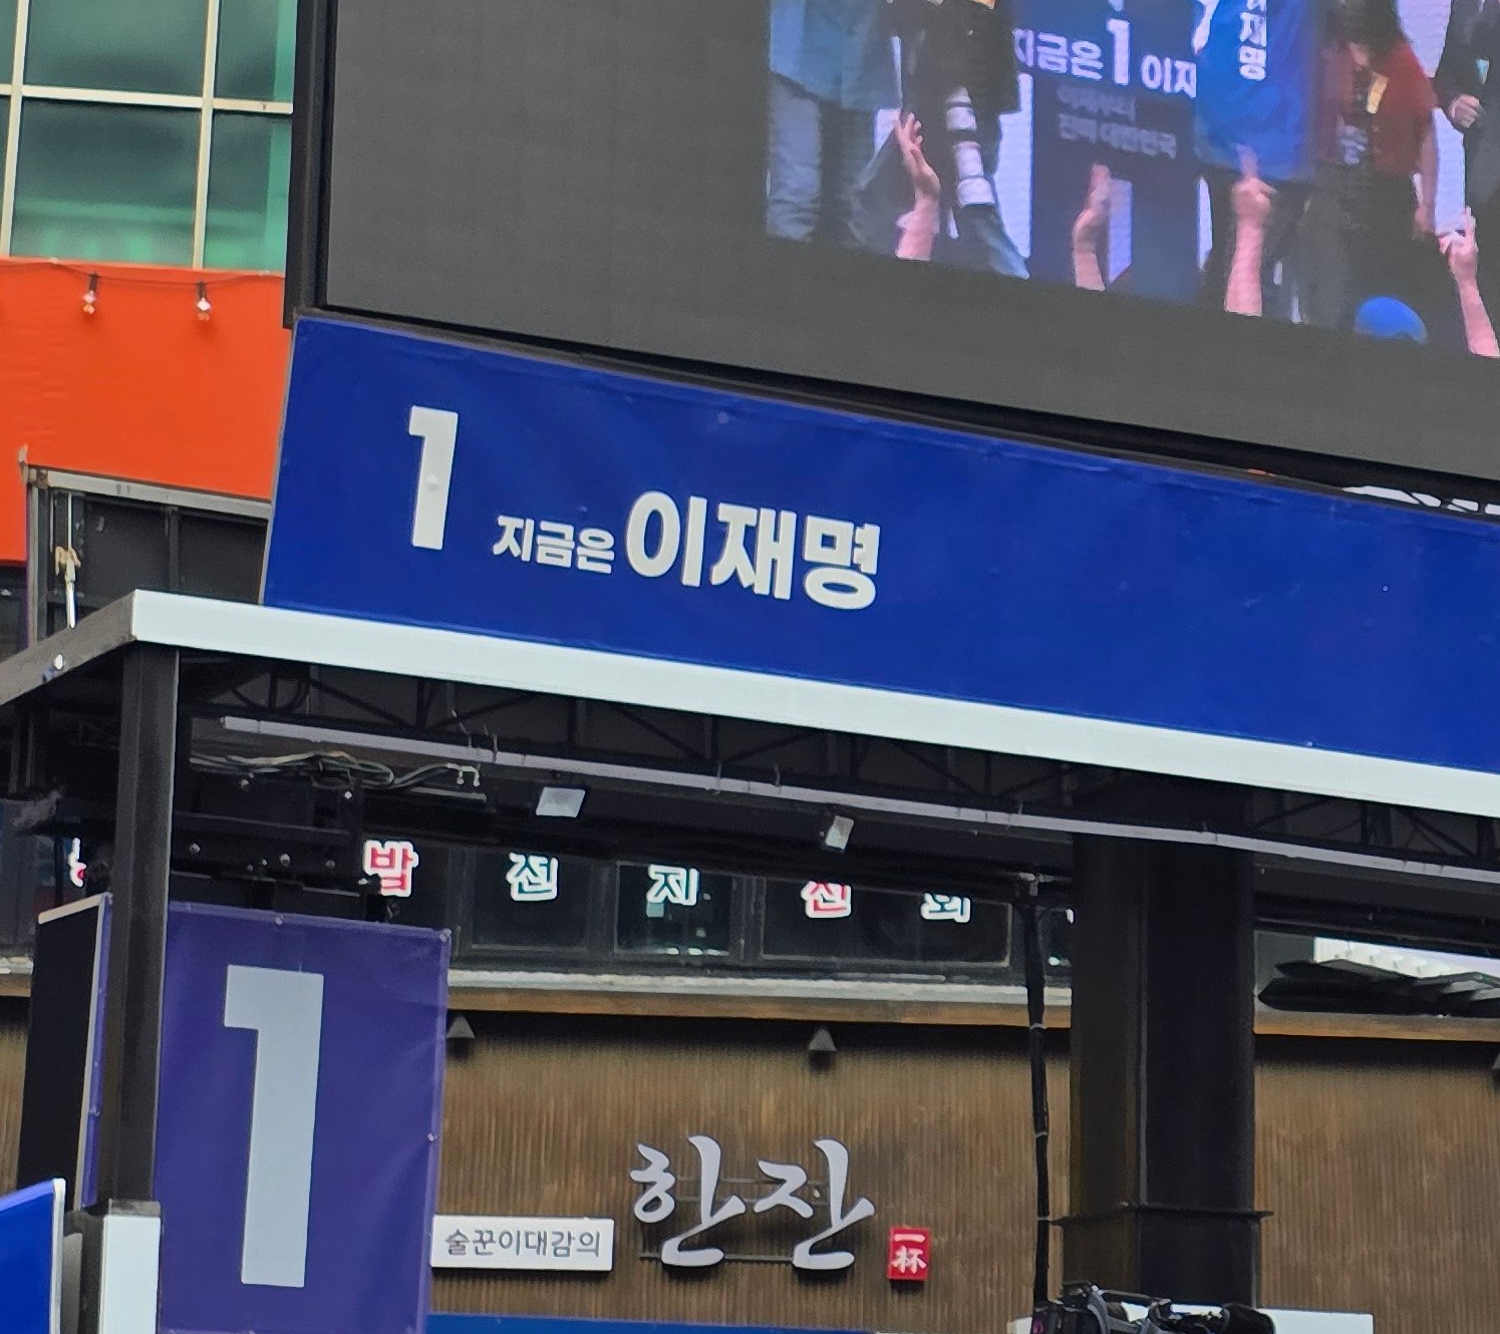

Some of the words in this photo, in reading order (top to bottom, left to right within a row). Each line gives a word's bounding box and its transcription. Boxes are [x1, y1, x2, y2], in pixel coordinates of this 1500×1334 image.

[408, 405, 459, 551] 1
[492, 514, 615, 574] 지금은
[625, 490, 881, 610] 이재명
[225, 964, 325, 1288] 1
[891, 1233, 928, 1275] 一杯
